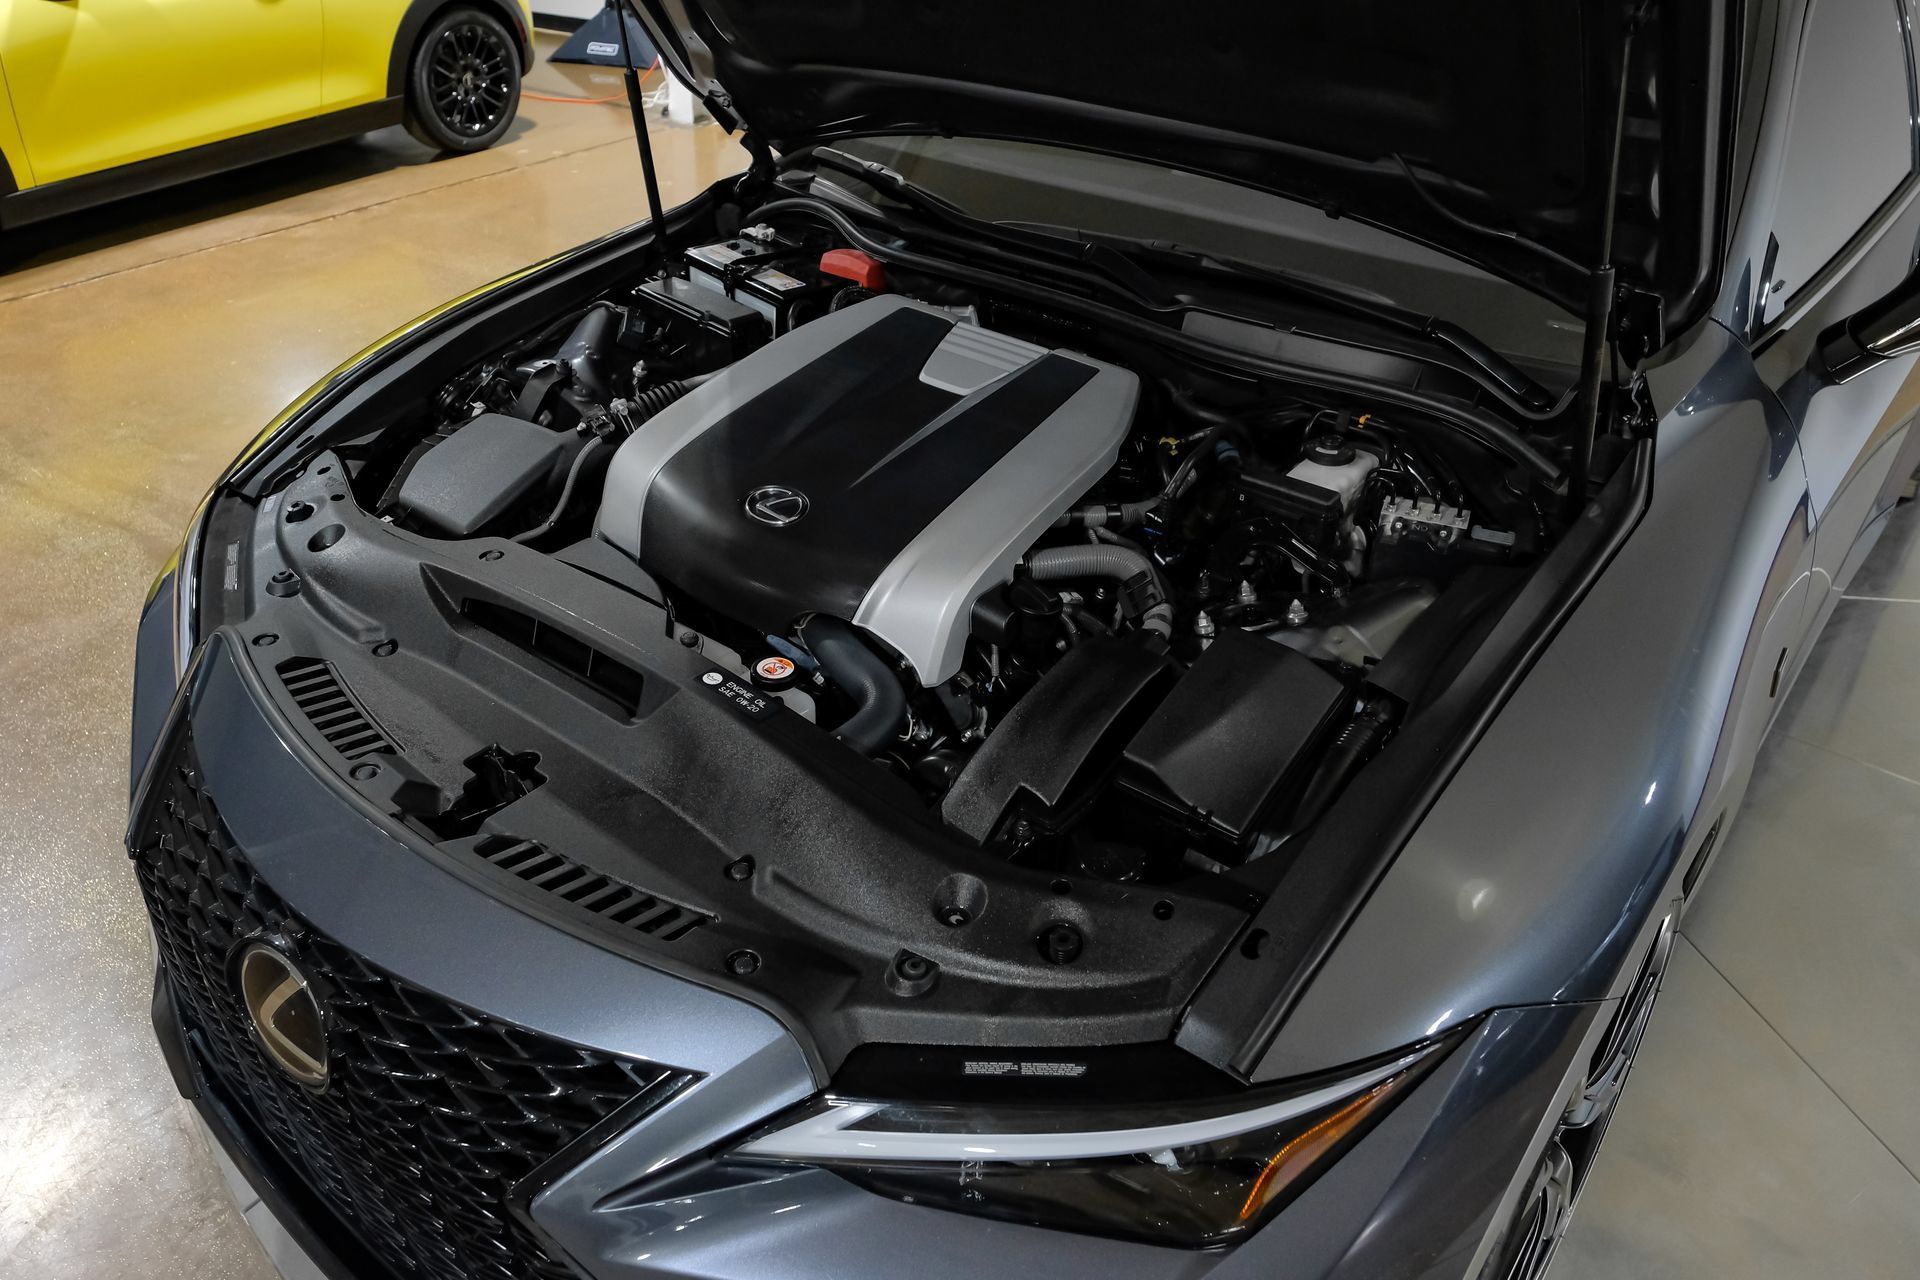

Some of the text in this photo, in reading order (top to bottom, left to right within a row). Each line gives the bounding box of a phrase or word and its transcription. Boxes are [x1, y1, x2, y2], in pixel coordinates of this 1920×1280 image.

[718, 686, 736, 698] SAE
[726, 681, 766, 709] ENGINE OIL
